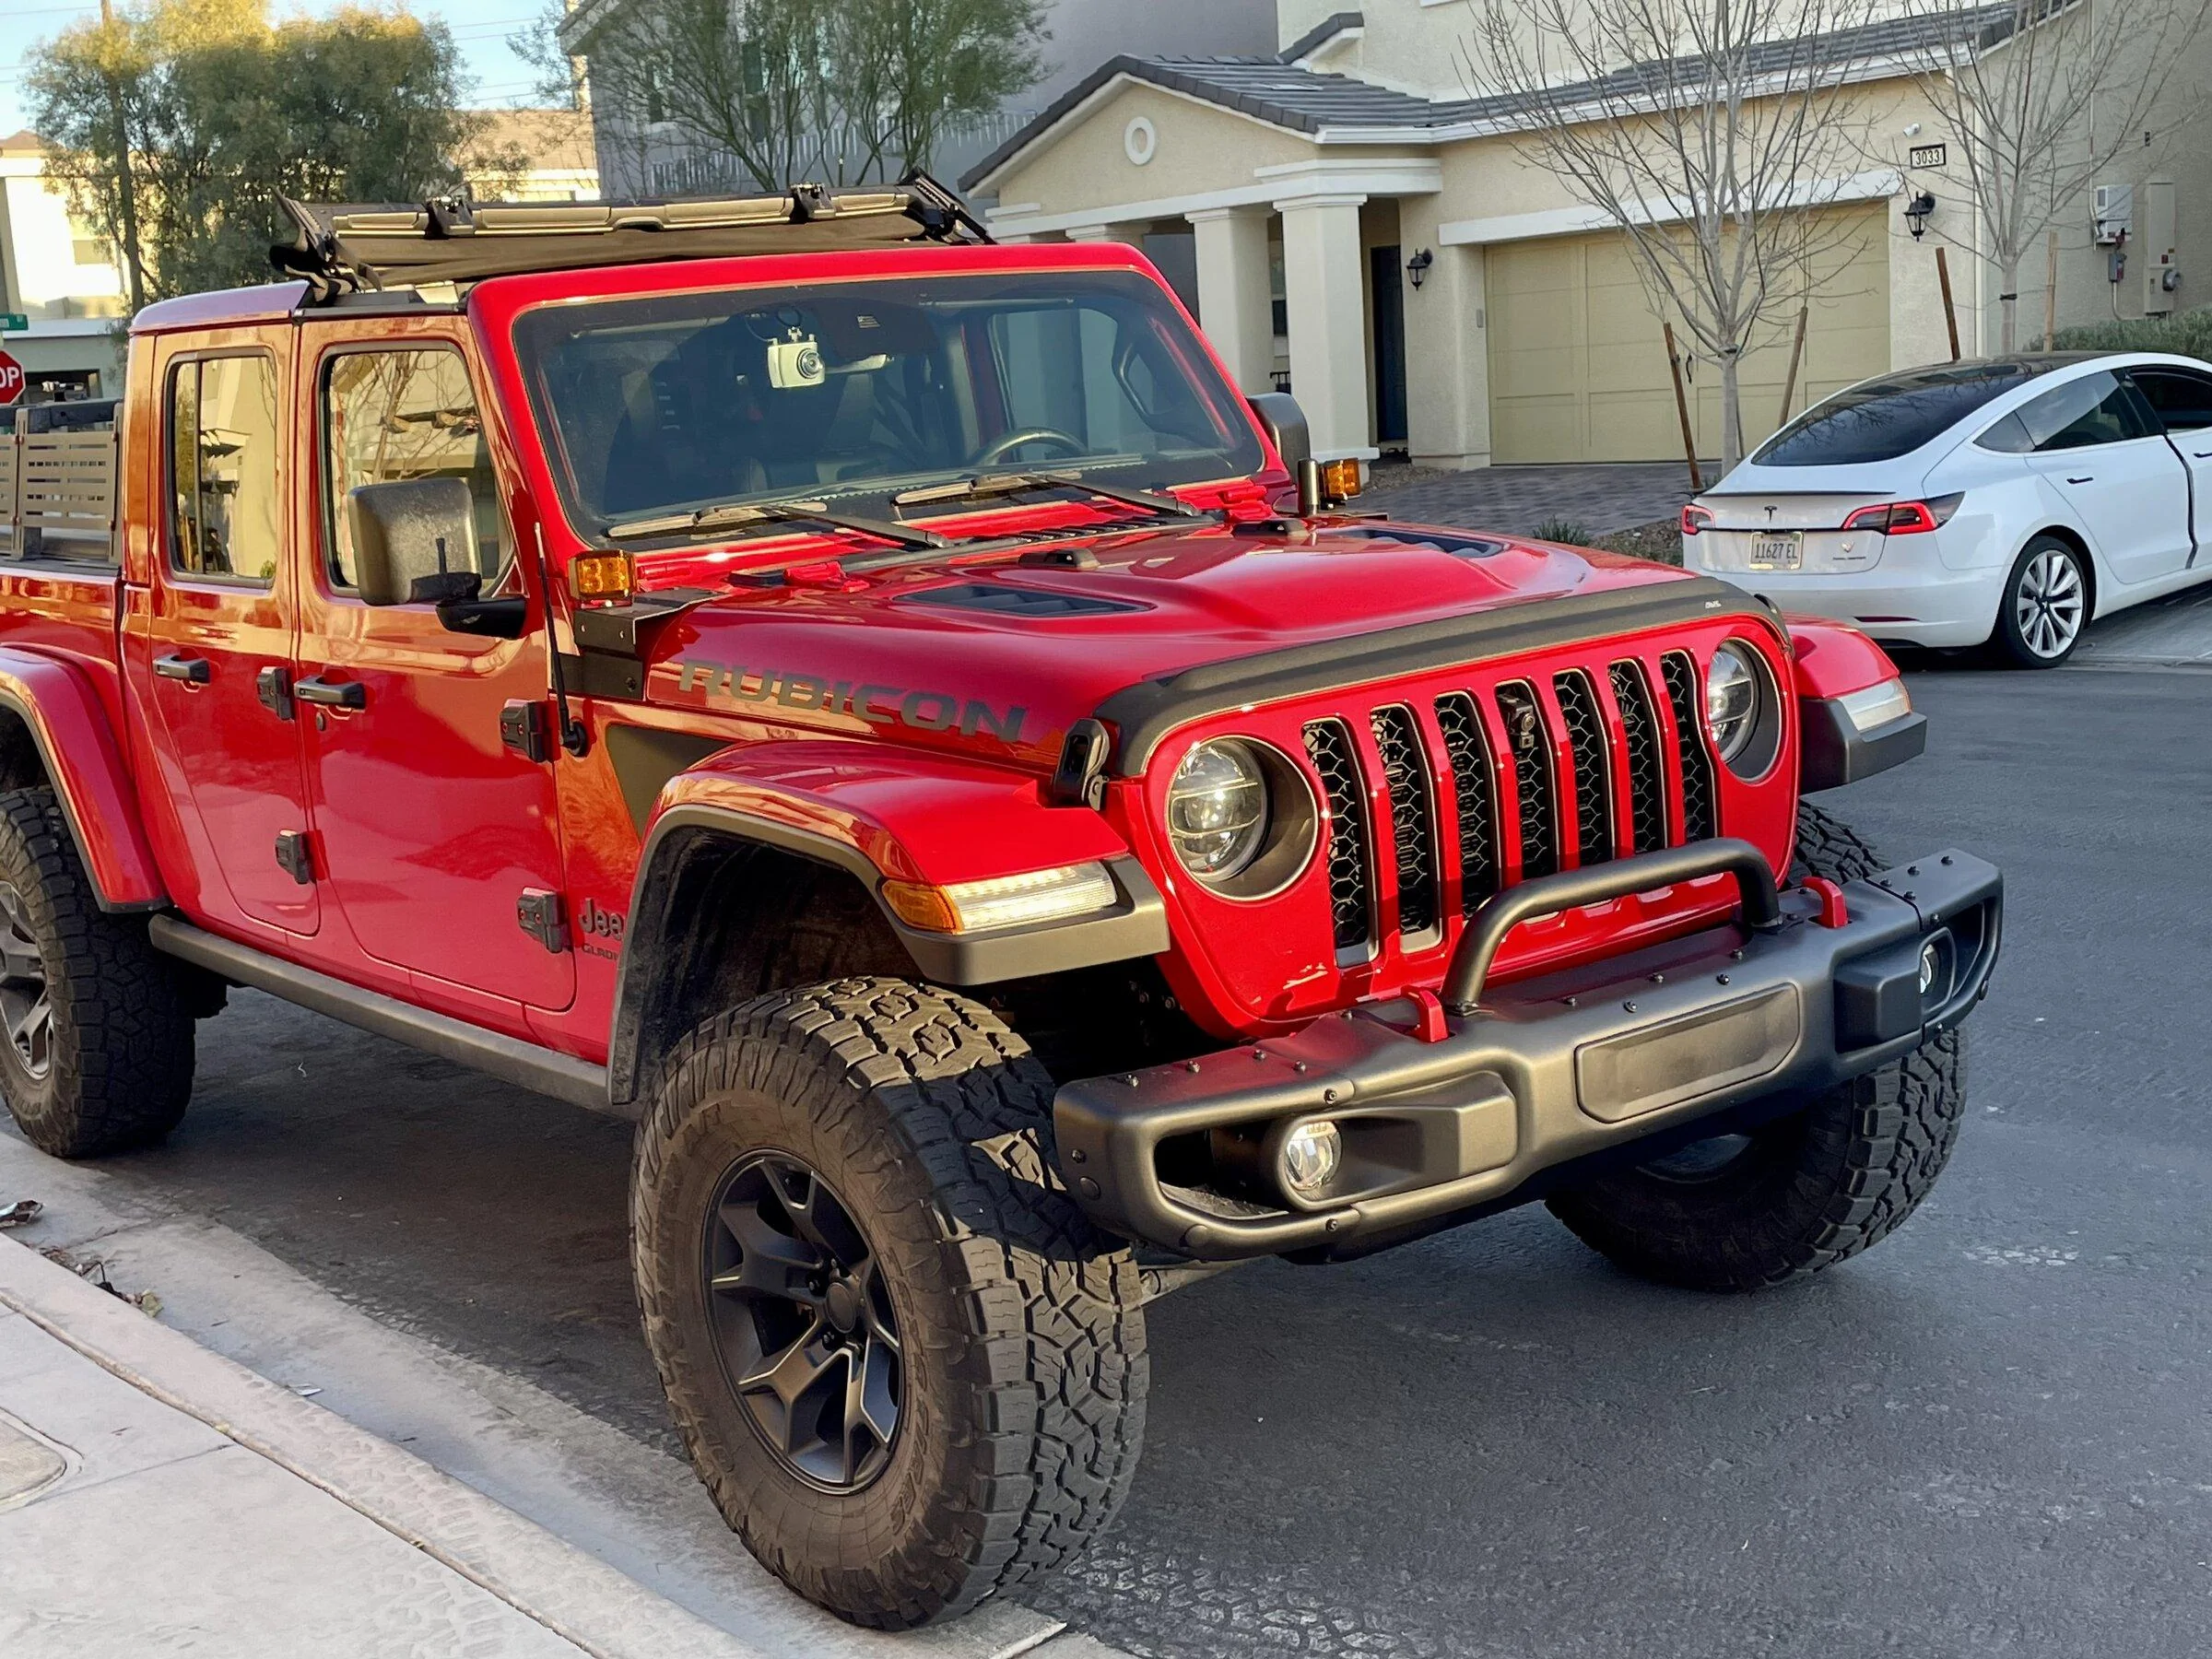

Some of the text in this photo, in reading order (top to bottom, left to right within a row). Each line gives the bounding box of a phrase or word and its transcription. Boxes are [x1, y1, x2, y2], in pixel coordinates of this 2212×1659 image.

[1915, 148, 1940, 166] 3033
[678, 658, 1027, 743] RUBICON
[577, 897, 624, 941] Jee
